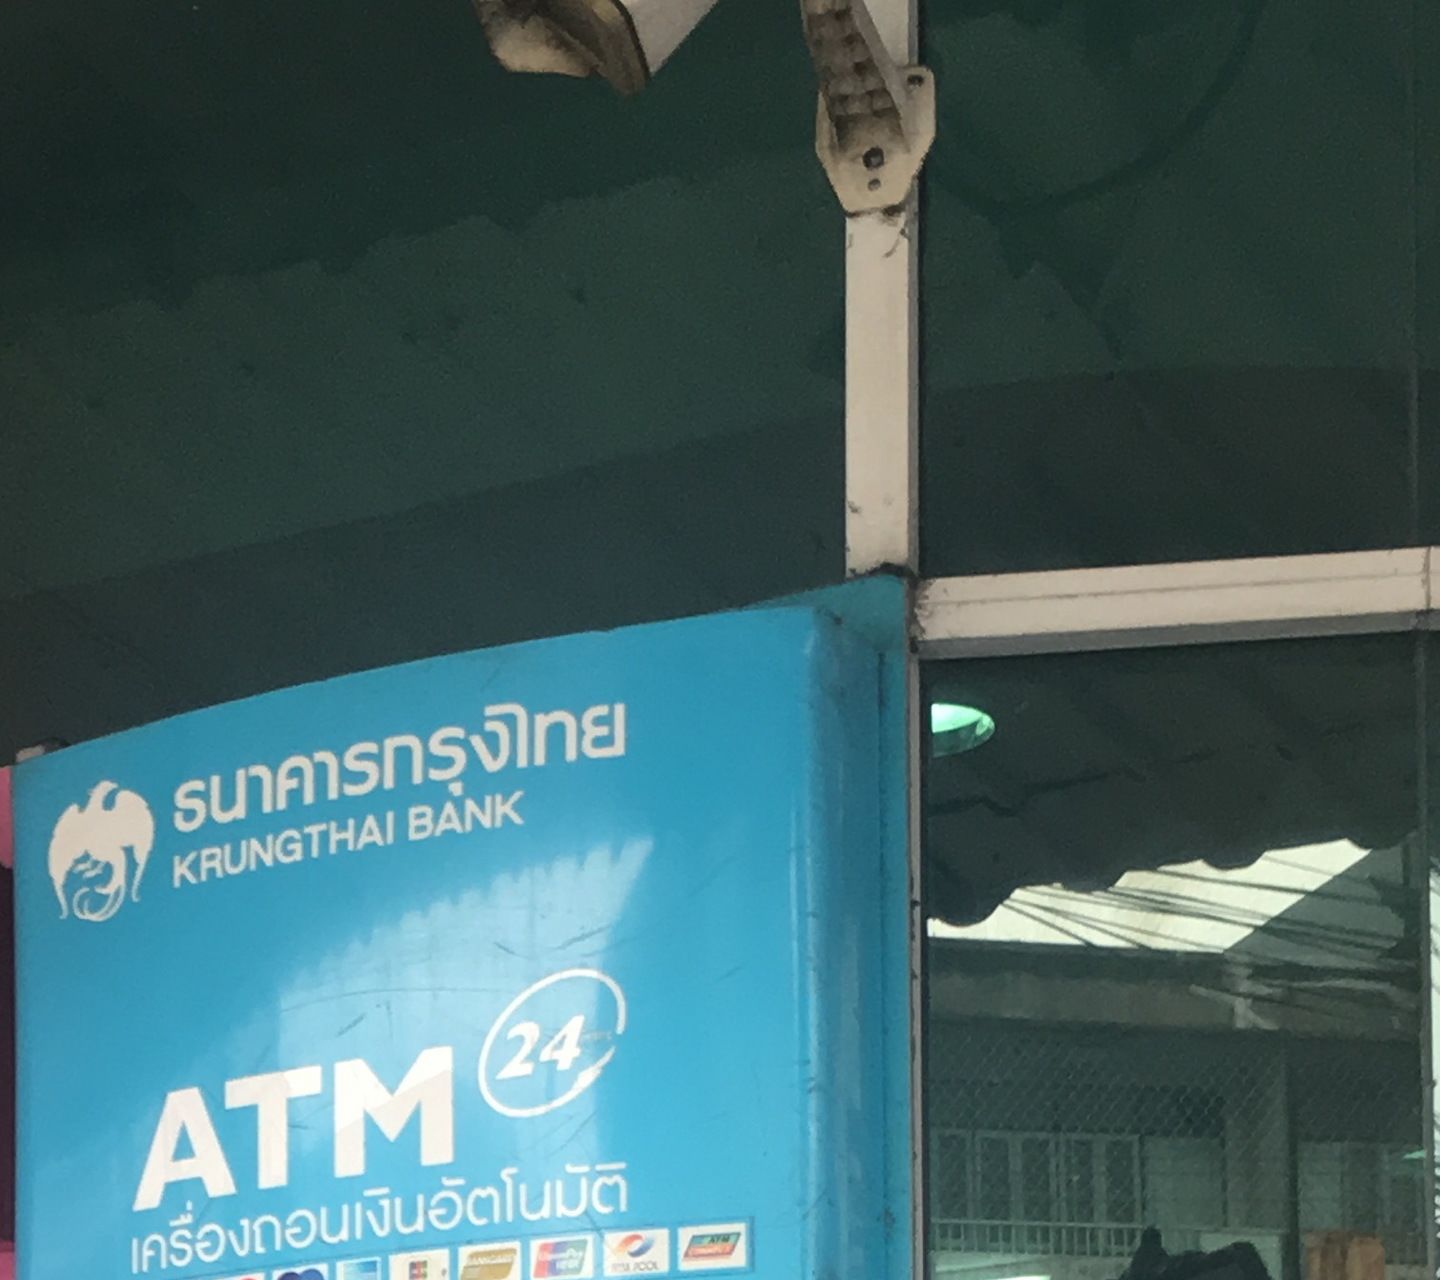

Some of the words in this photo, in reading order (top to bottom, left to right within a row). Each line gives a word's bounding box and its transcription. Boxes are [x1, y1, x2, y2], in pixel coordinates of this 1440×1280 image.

[172, 702, 627, 833] ธนาคารกรุงไทย
[172, 821, 395, 889] KRUNGTHAI
[408, 791, 524, 840] BANK
[494, 1015, 587, 1082] 24
[131, 1045, 456, 1211] ATM
[132, 1162, 627, 1274] เครื่องถอนเงินอัตโนมัติ
